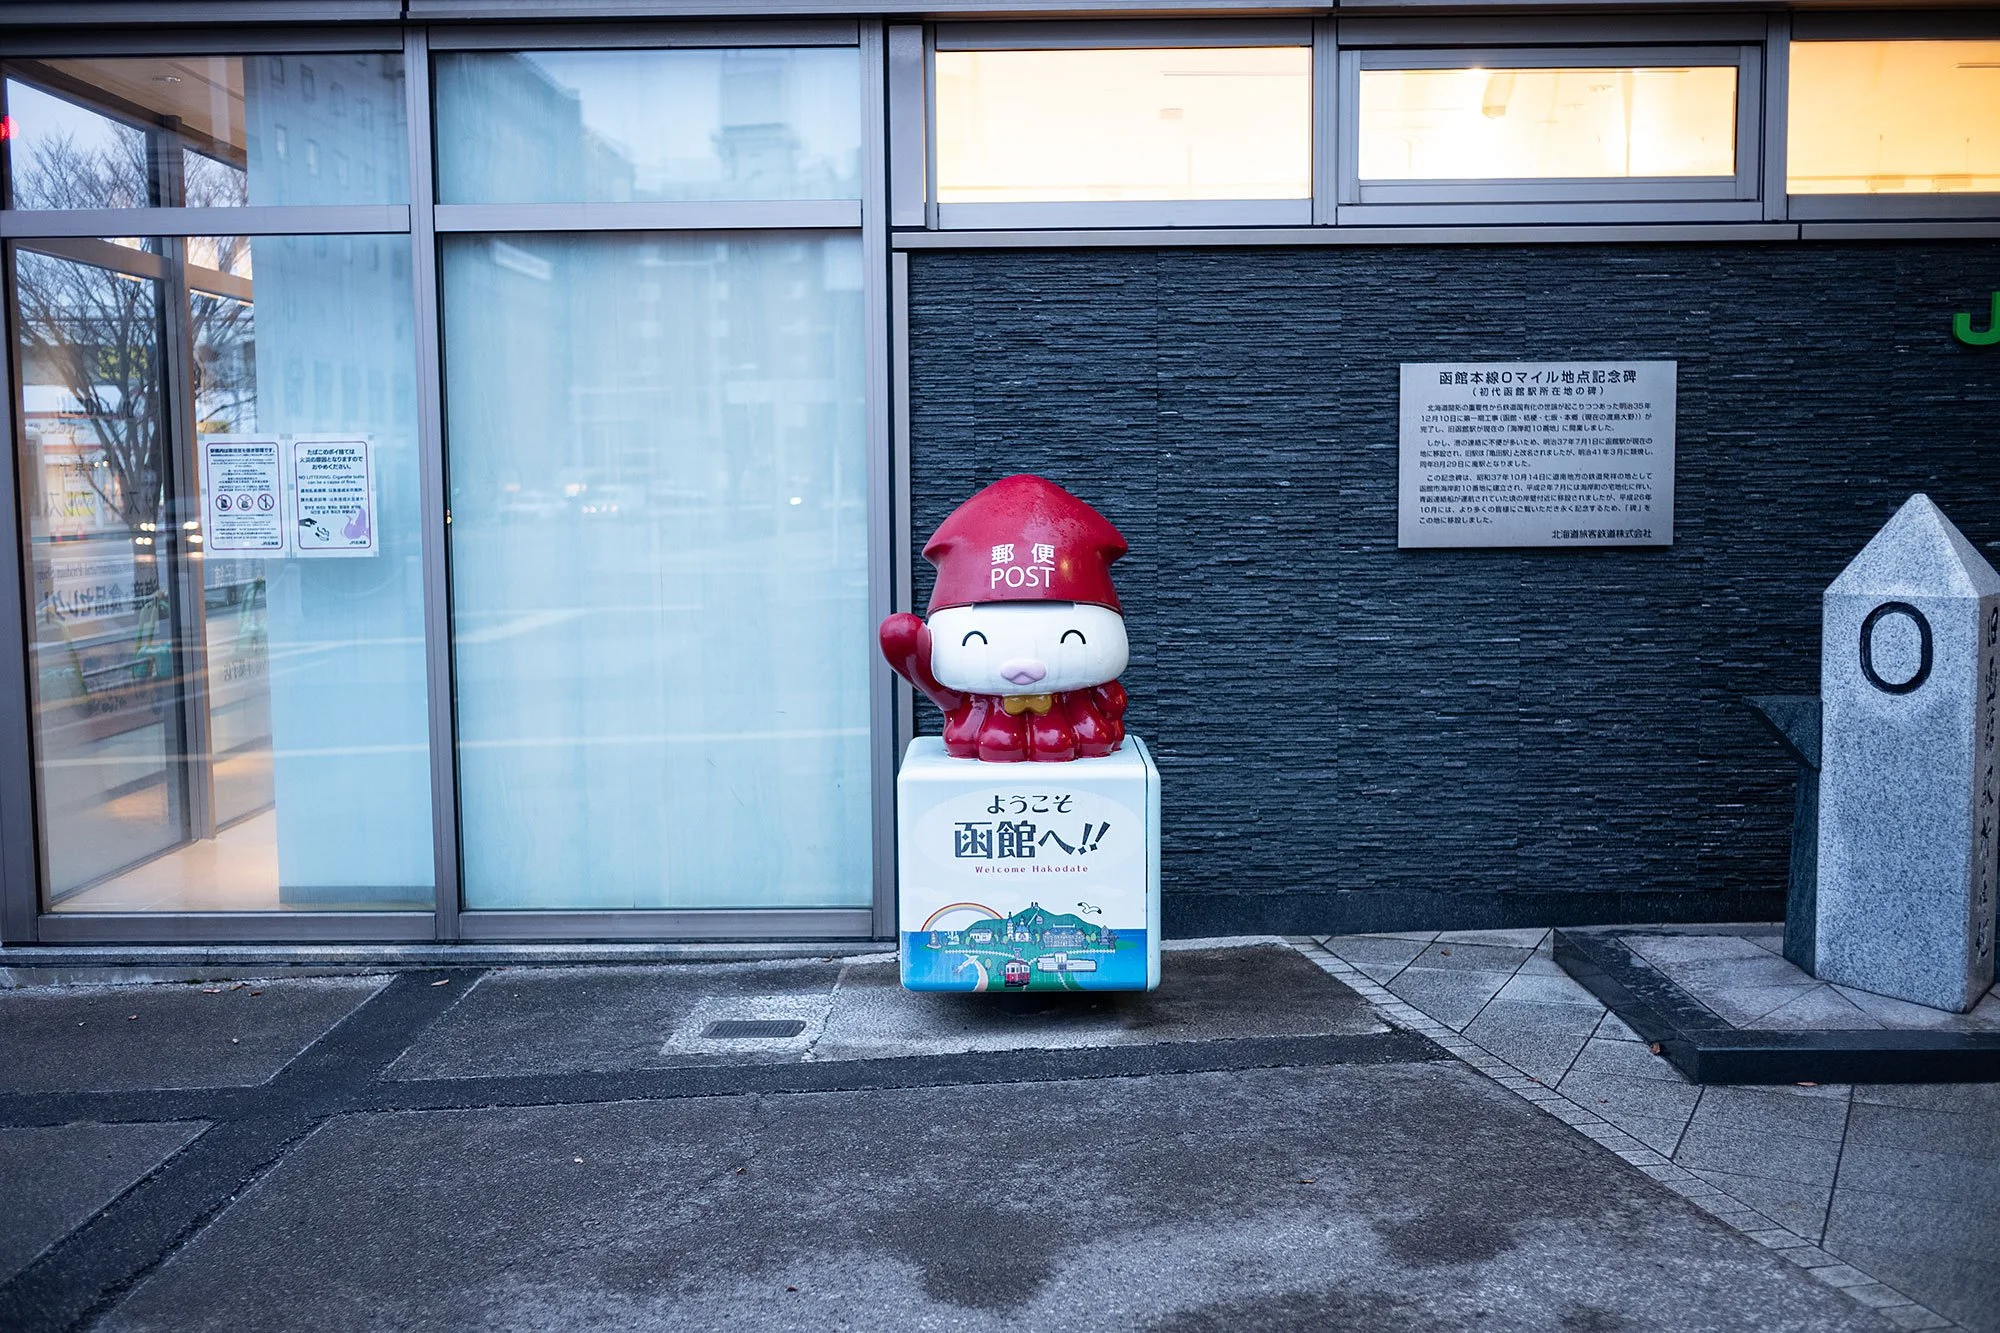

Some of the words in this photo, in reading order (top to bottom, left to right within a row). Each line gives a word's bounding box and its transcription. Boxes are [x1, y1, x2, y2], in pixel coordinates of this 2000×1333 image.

[1551, 528, 1652, 539] 北海道旅客鉄道株式会社
[990, 542, 1056, 566] 郵便
[990, 566, 1056, 590] POST
[987, 794, 1073, 814] ようこそ
[975, 865, 1026, 874] Welcome
[1032, 864, 1089, 873] Hakodate
